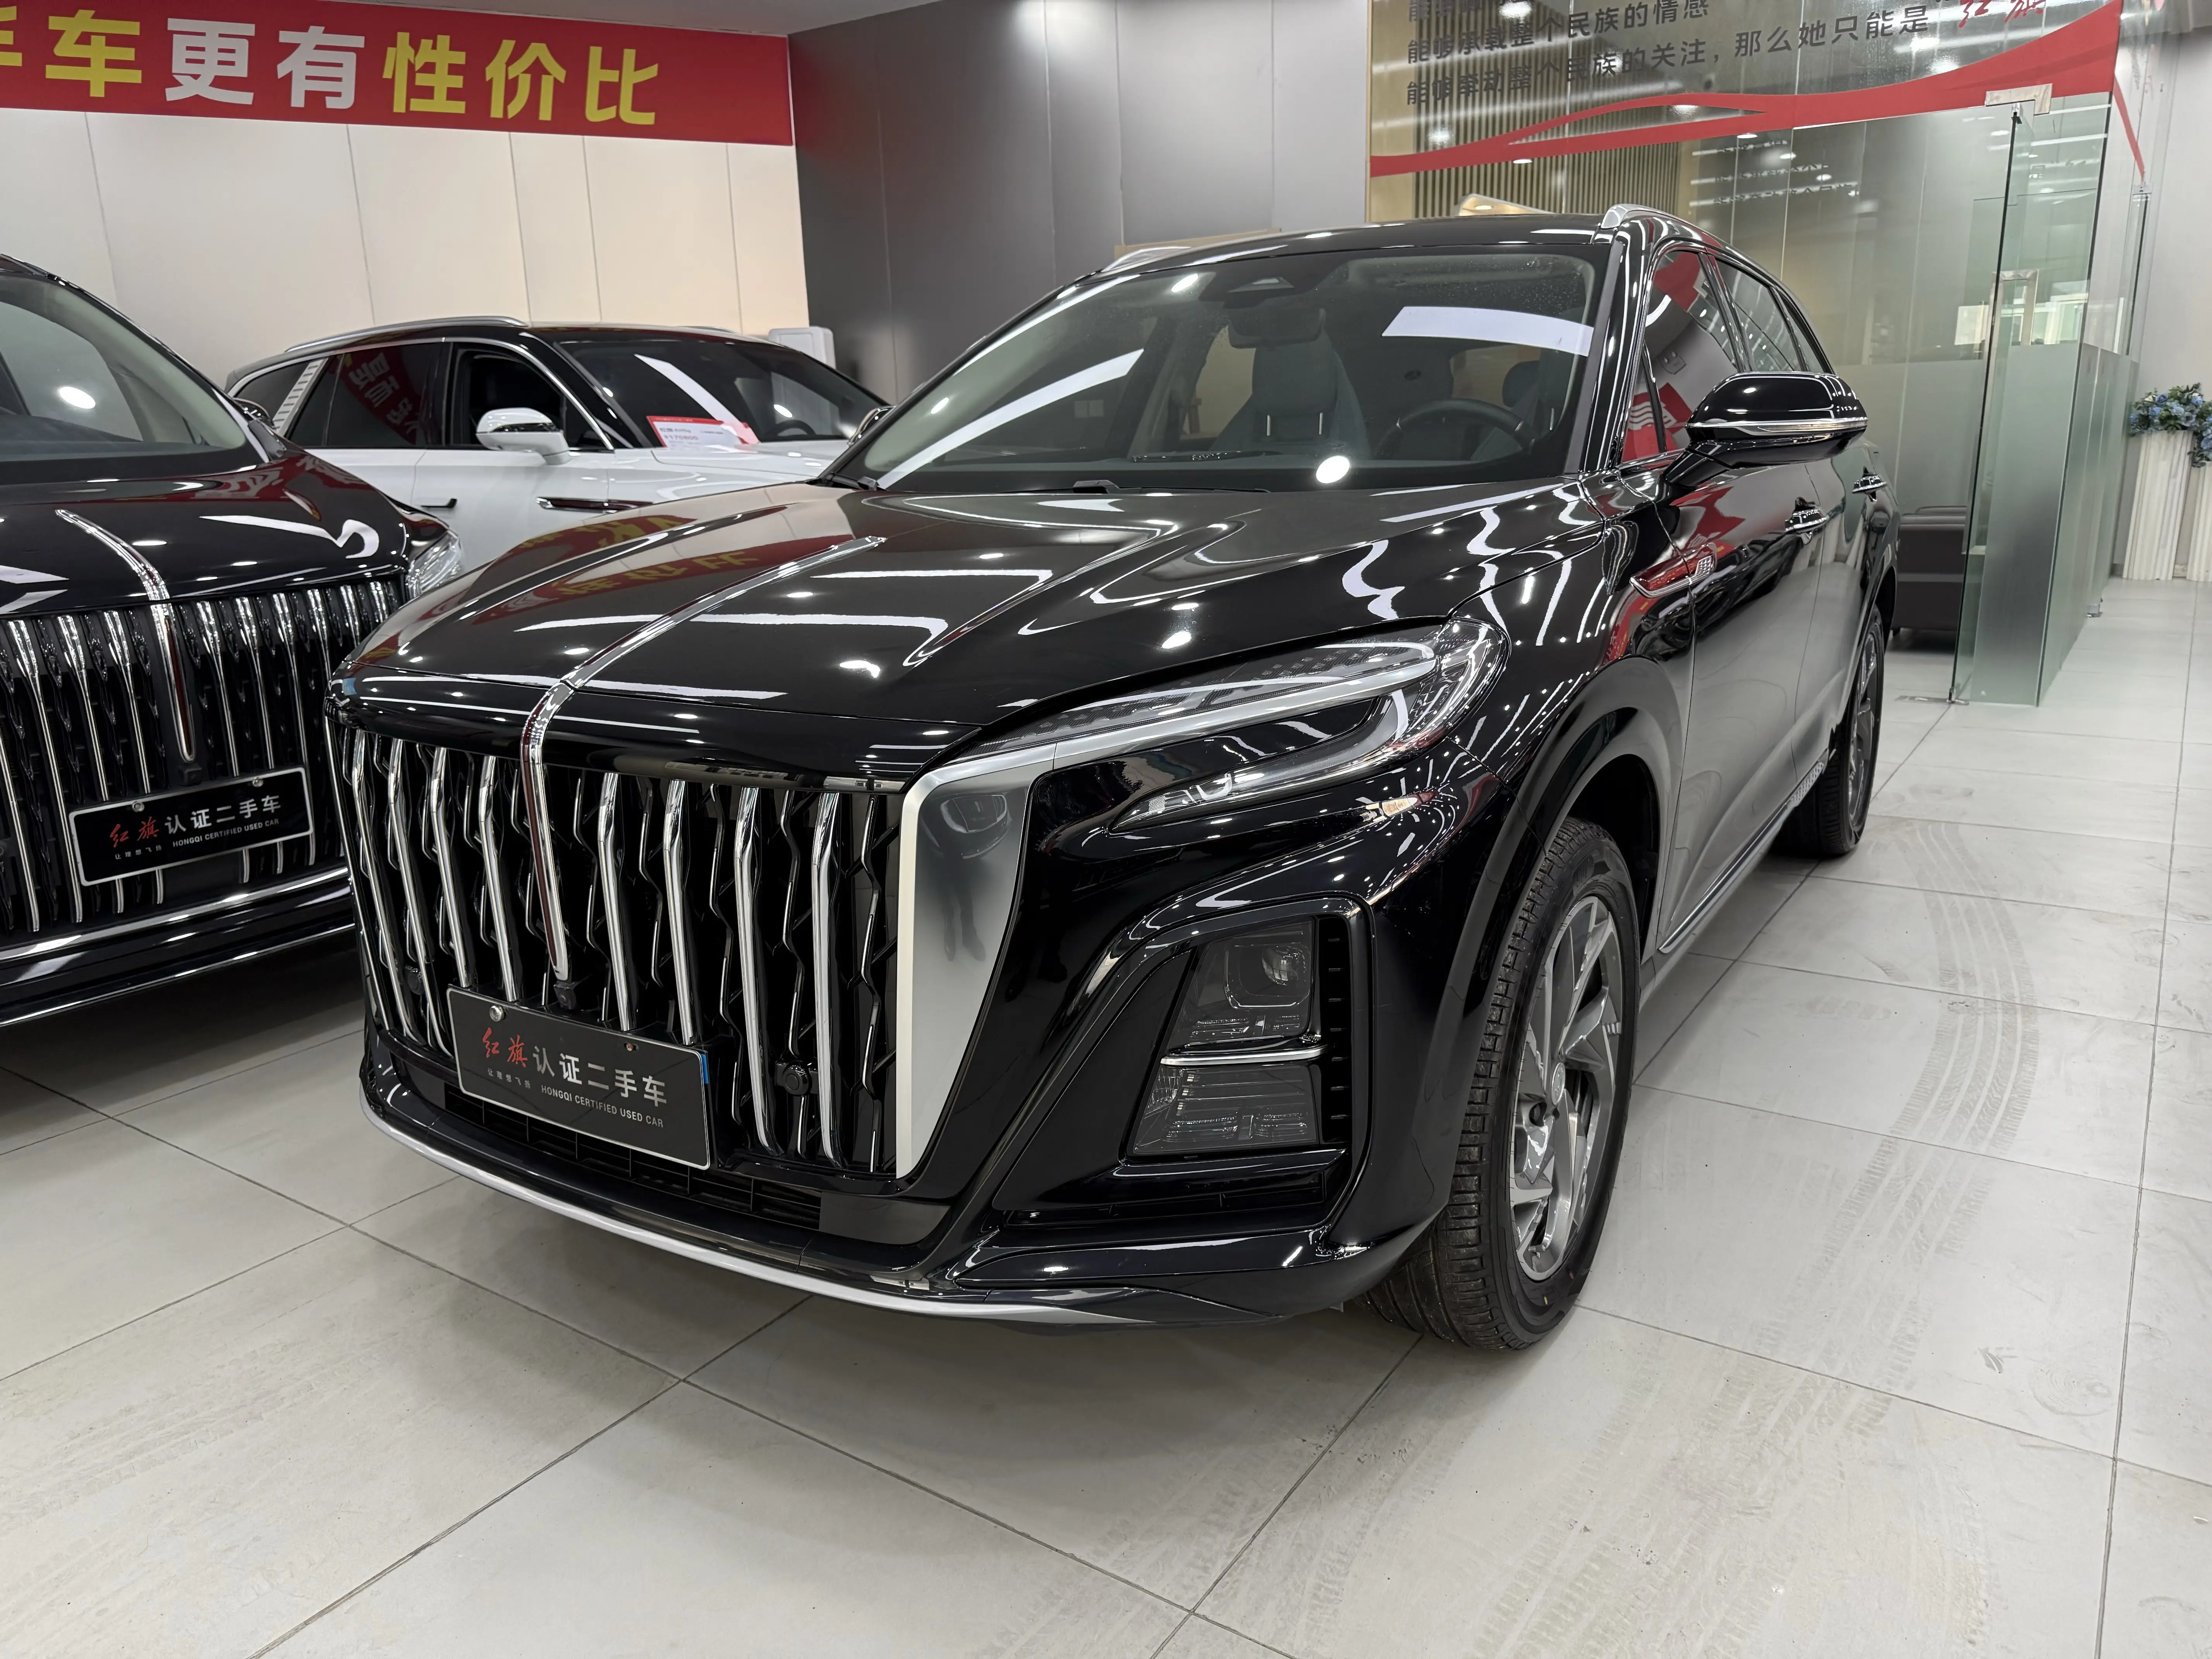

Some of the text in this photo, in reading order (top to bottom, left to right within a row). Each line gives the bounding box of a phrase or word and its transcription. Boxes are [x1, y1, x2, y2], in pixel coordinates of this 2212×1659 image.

[0, 6, 659, 125] 车更有性价比
[173, 818, 279, 847] HONGQI CERTIFIED USED CAR
[541, 1085, 664, 1128] HONGQI CERTIFIED USED CAR
